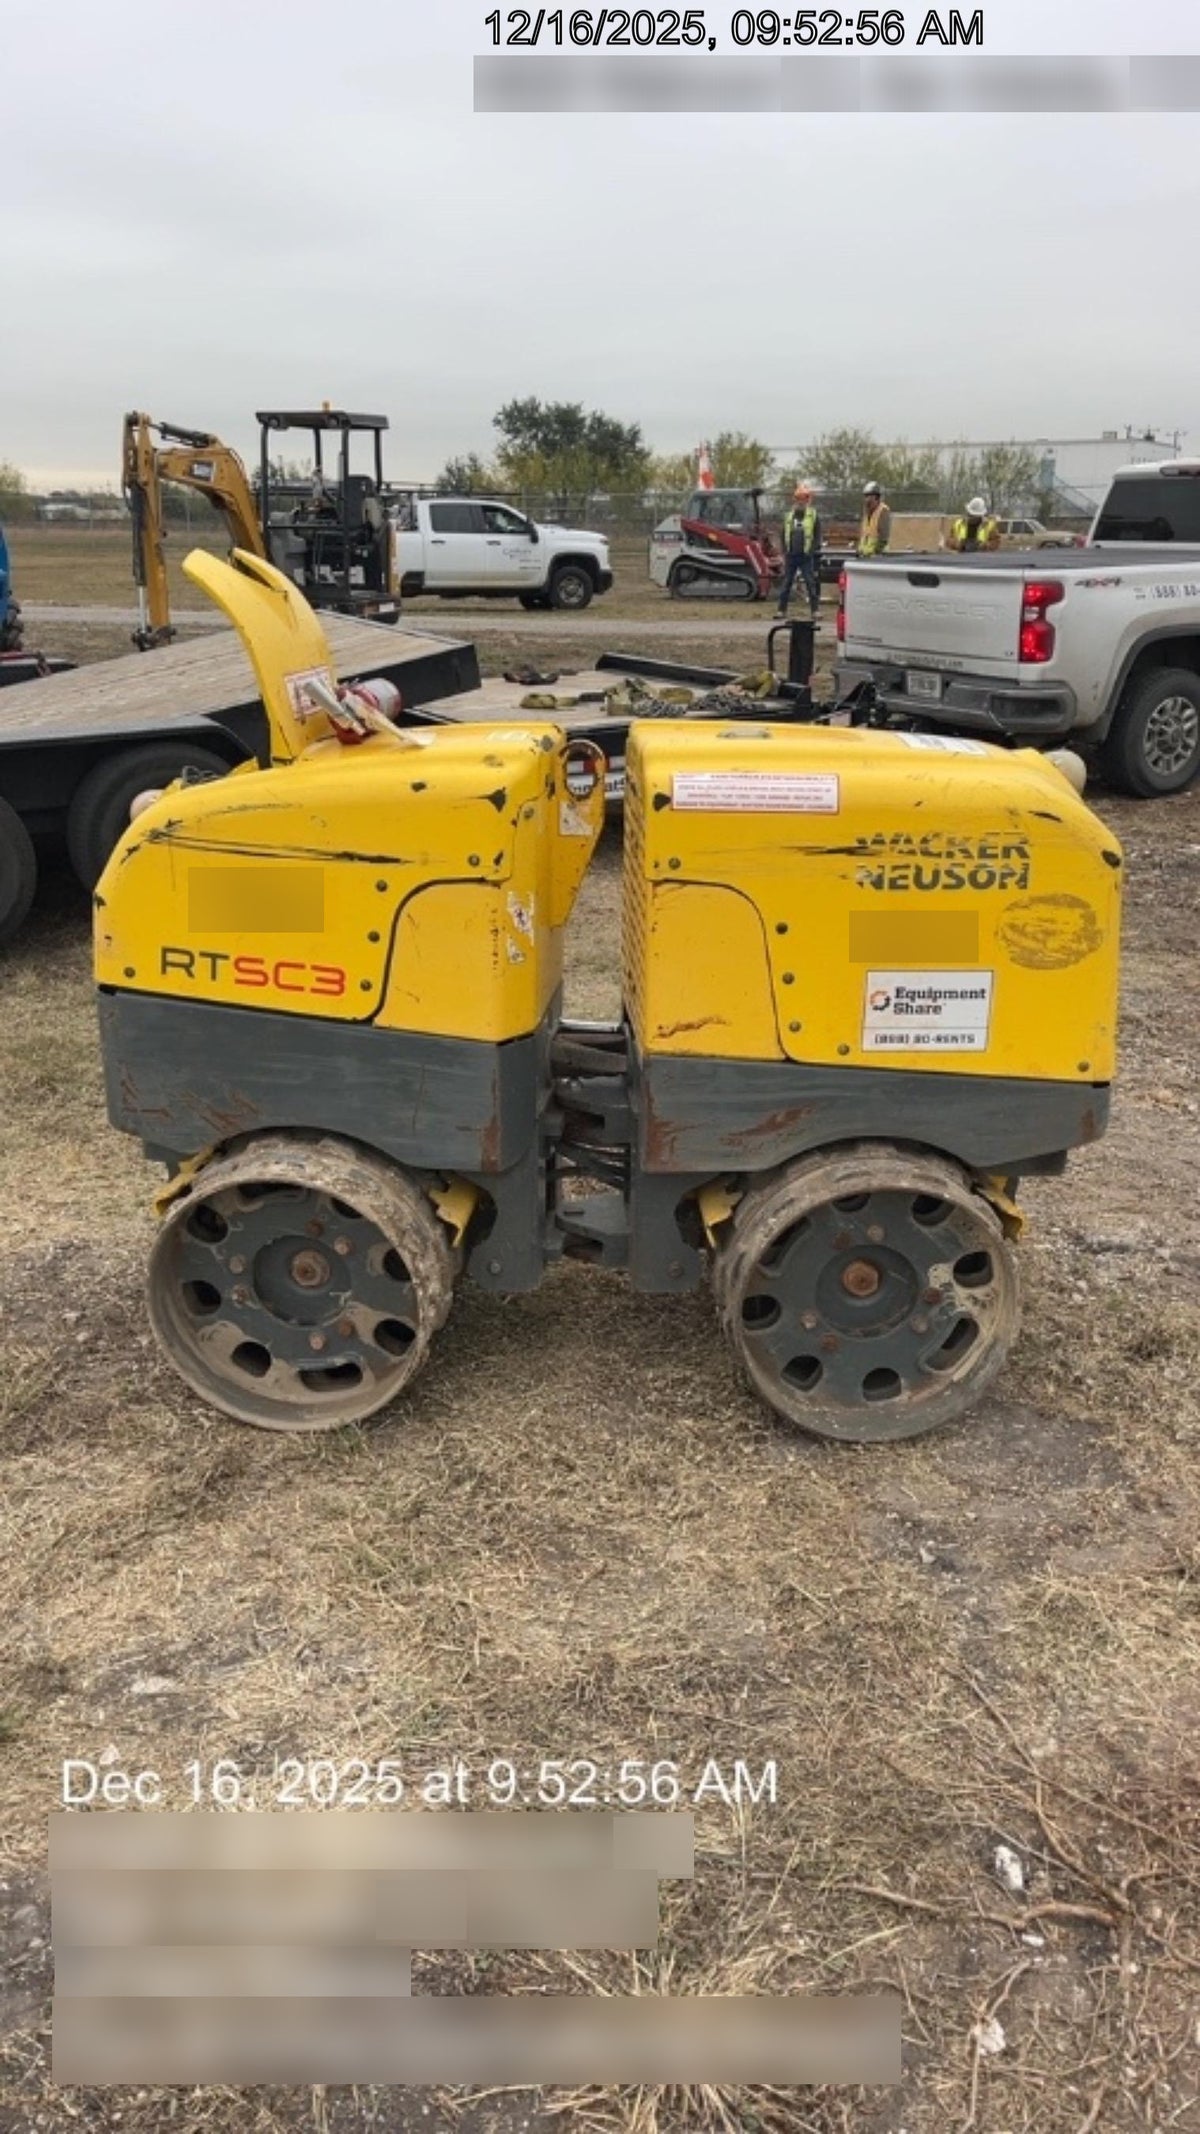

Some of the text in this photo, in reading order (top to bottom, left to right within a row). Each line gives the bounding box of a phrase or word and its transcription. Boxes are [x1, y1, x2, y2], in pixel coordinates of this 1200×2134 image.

[856, 863, 1030, 890] NEUSON
[161, 946, 346, 997] RTSC3
[895, 986, 986, 1003] Equipment
[893, 1003, 942, 1015] Share
[874, 1033, 976, 1045] (888) 80-RENTS
